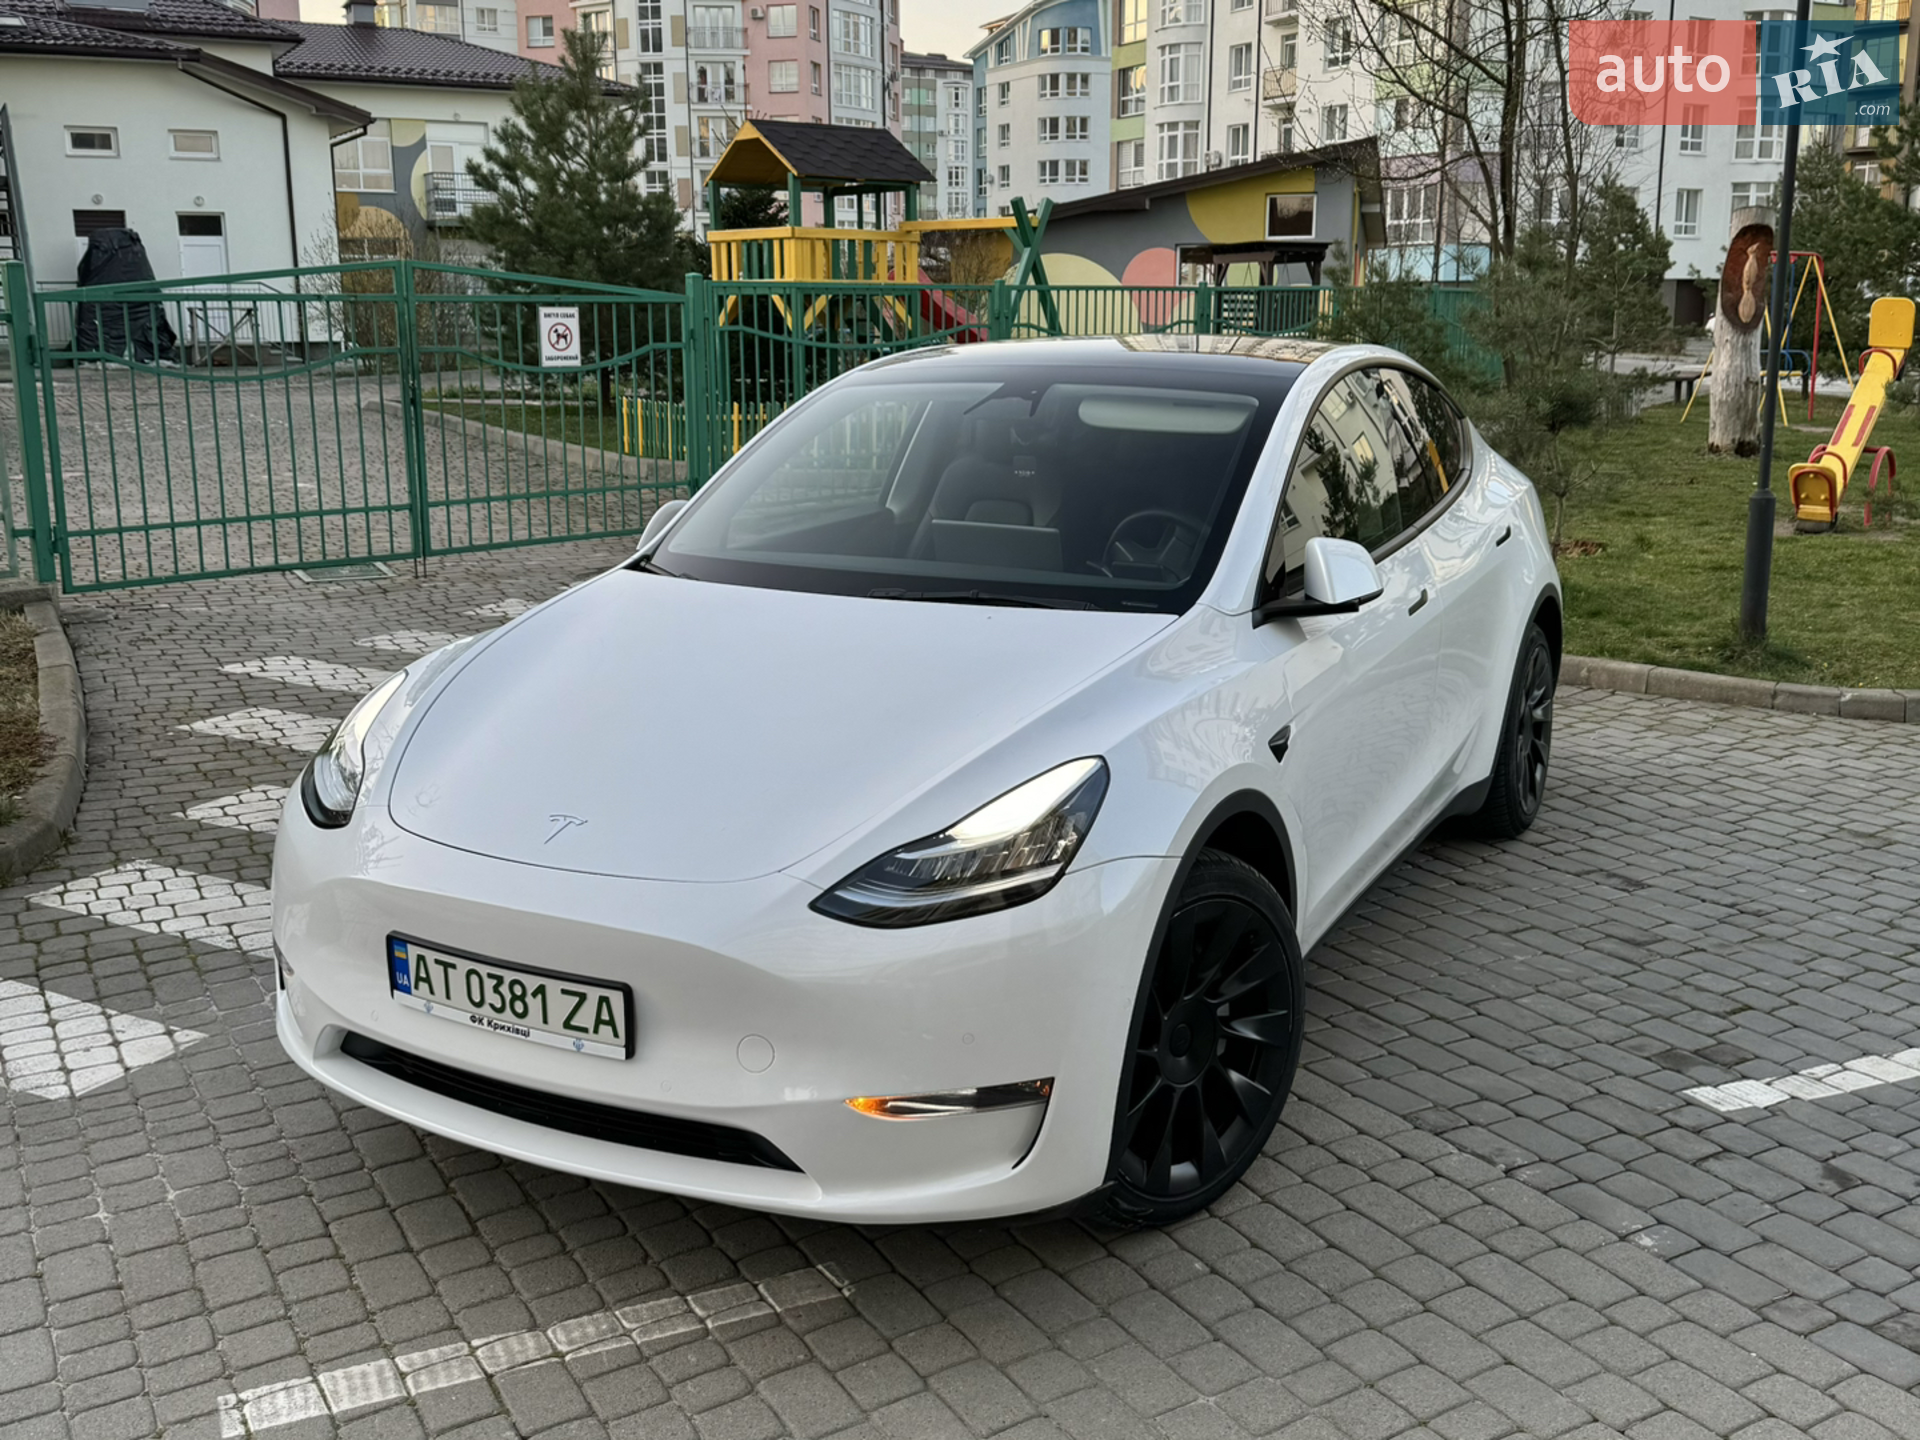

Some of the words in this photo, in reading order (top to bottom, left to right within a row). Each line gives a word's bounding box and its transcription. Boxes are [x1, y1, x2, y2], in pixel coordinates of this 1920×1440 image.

[396, 971, 410, 988] UA
[413, 953, 457, 1000] AT
[465, 967, 549, 1026] 0381
[560, 987, 620, 1039] ZA
[469, 1014, 485, 1027] ФК
[486, 1018, 530, 1039] Крихівці
